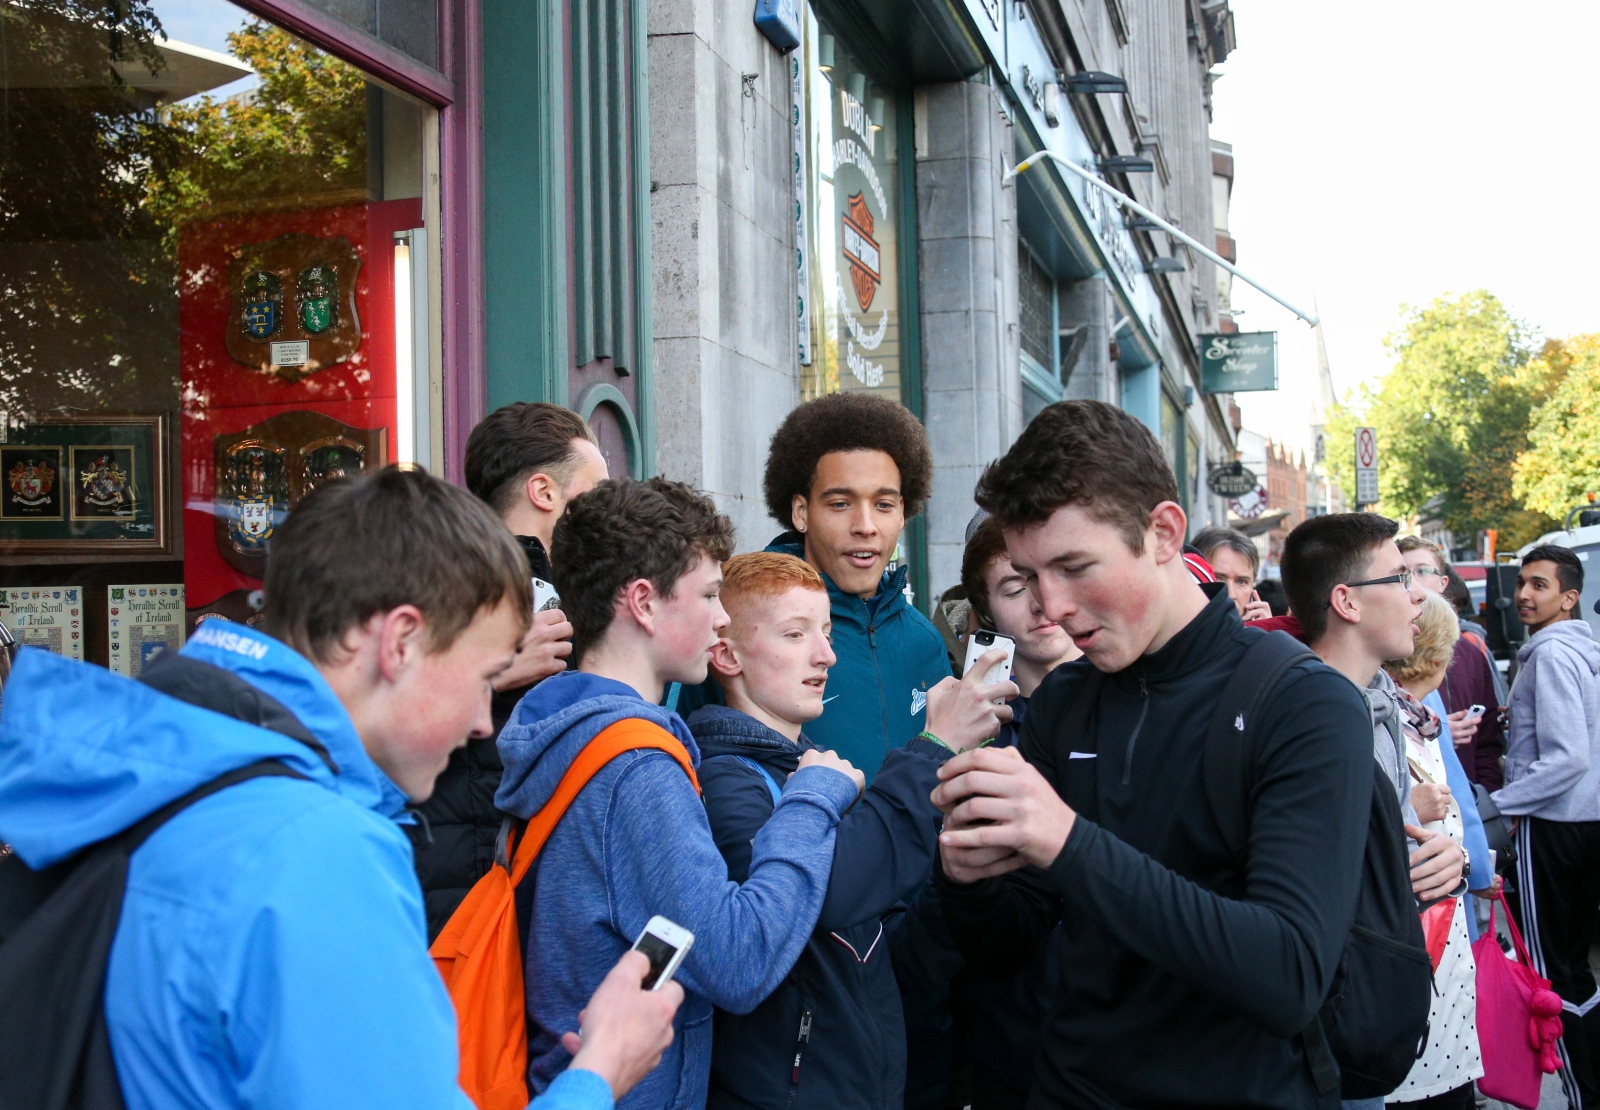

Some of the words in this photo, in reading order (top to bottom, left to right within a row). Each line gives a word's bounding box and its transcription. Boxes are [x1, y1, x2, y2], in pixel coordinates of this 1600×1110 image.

[841, 90, 876, 157] DUBLIN
[1205, 336, 1271, 360] Sweater
[847, 341, 865, 384] Sold
[865, 361, 884, 388] Here
[1222, 357, 1258, 375] Shop
[9, 602, 39, 615] Heraldic
[40, 602, 63, 614] Scroll
[127, 599, 156, 612] Heraldic
[157, 598, 180, 611] Scroll
[18, 615, 25, 626] of
[28, 614, 55, 626] Ireland
[135, 613, 143, 623] of
[145, 611, 172, 623] Ireland
